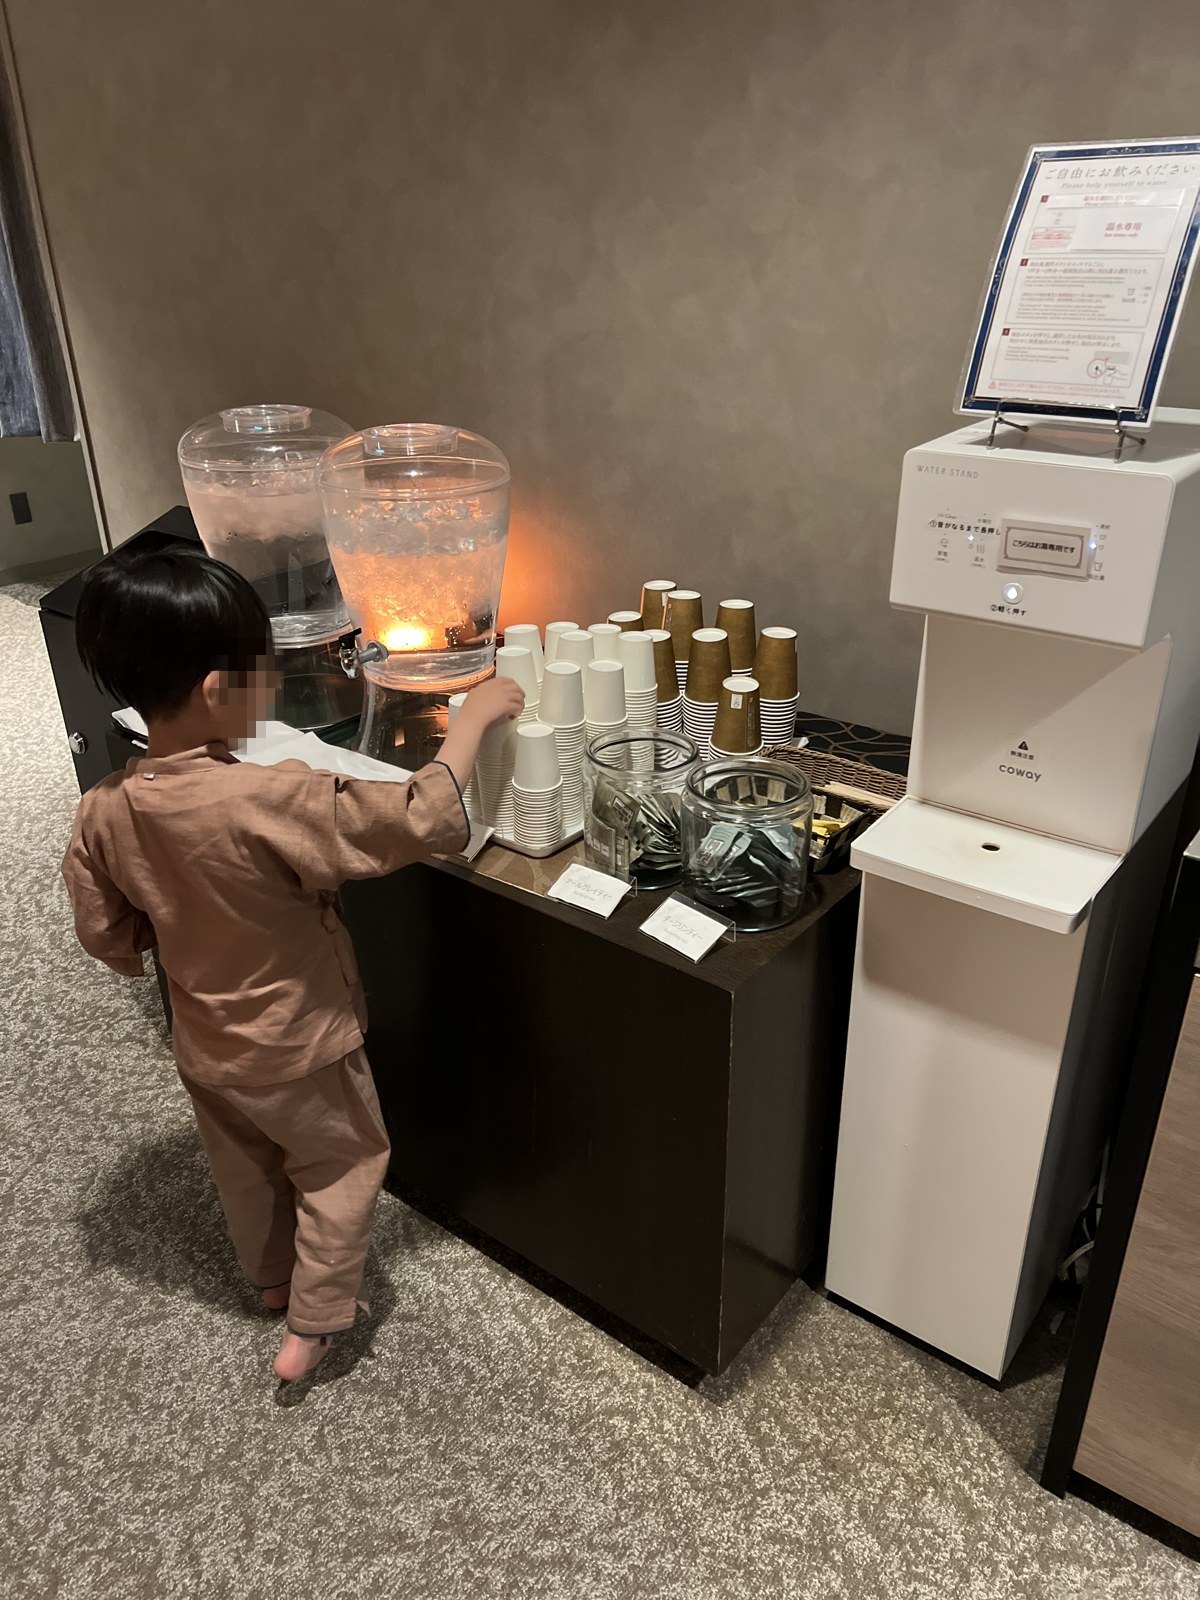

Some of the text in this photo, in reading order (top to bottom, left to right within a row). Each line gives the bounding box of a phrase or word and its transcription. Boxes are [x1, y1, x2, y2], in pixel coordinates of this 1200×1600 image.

[1045, 163, 1196, 180] ご自由にお飲みください
[917, 464, 979, 479] WATER STAND
